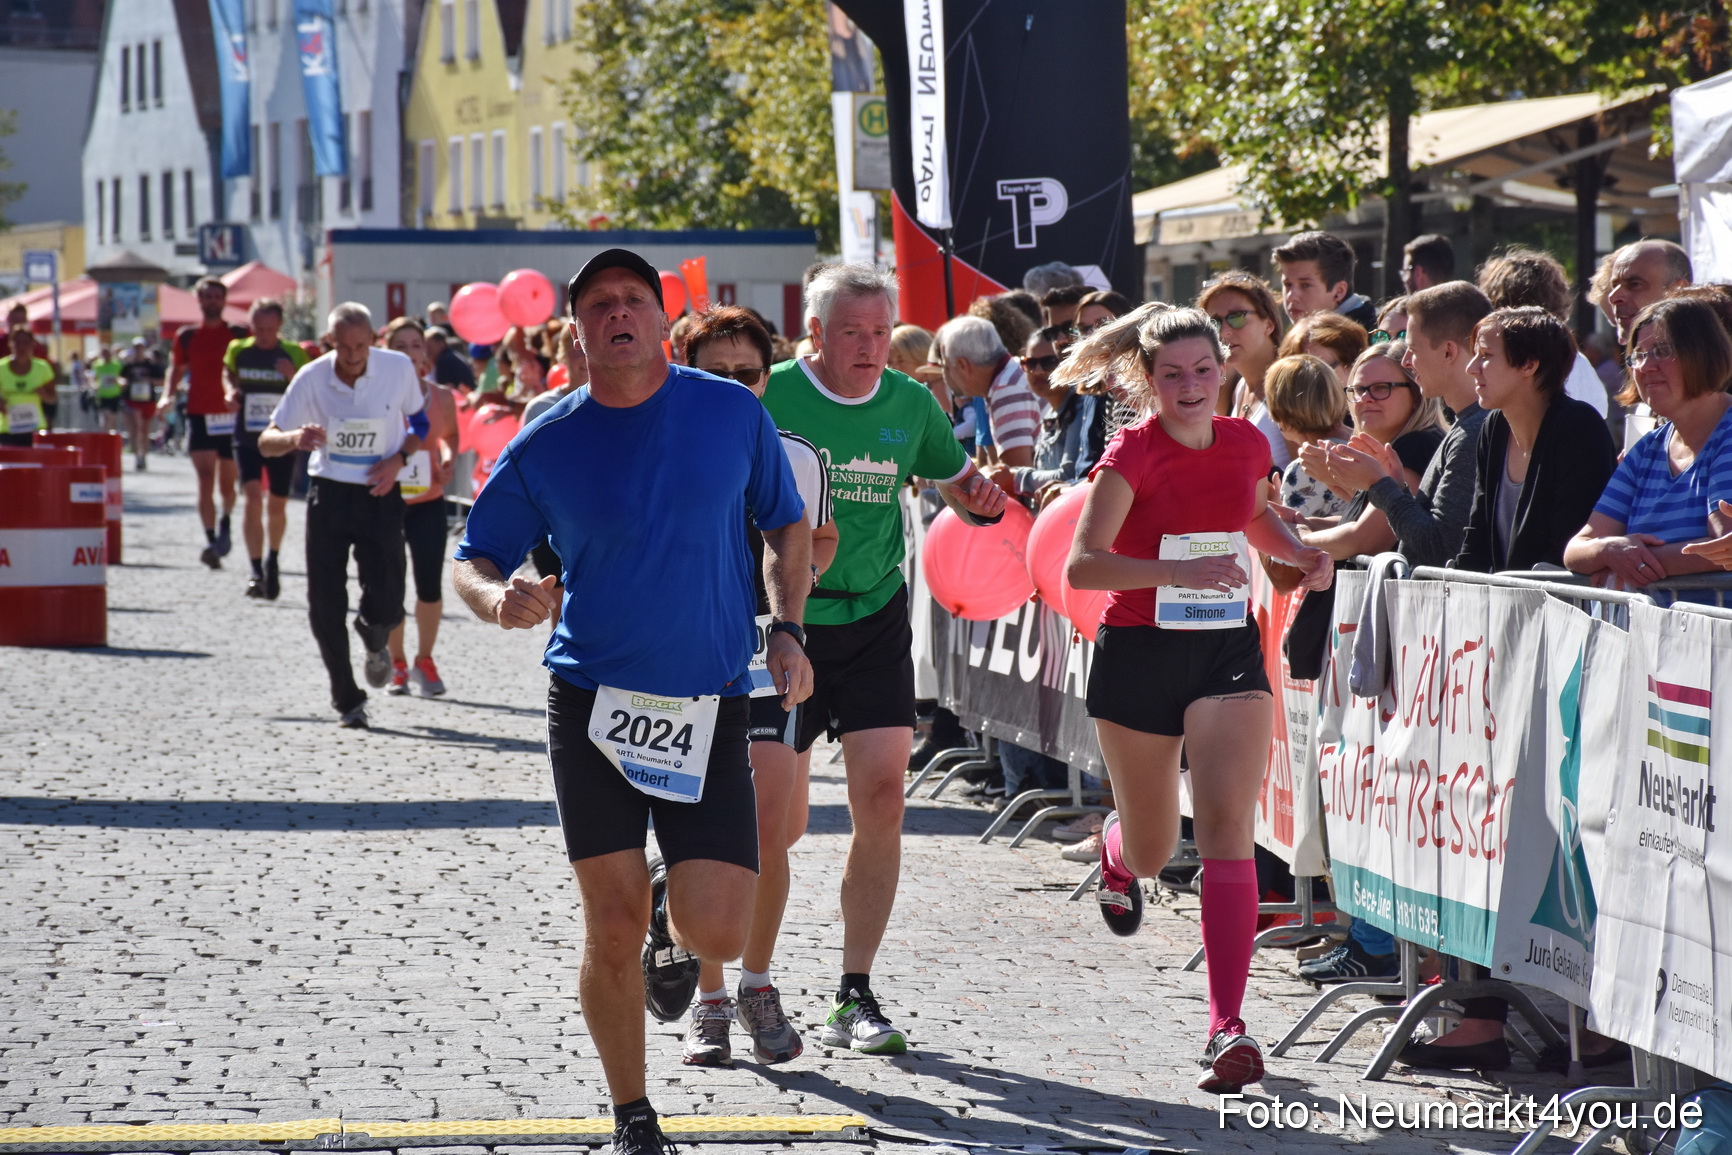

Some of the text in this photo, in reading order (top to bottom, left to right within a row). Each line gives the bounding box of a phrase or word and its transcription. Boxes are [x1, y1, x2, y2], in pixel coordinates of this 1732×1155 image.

[869, 110, 885, 128] H
[1002, 185, 1023, 193] Team
[336, 432, 377, 449] 3077
[829, 471, 897, 487] ENSBURGER
[1190, 542, 1229, 552] BOCK
[1201, 591, 1226, 600] Neumarkt
[1185, 606, 1226, 619] Simone
[632, 695, 682, 712] BOCK
[606, 709, 693, 756] 2024
[615, 748, 671, 766] ARTL Neumarkt
[1525, 938, 1551, 969] Jura
[1668, 1001, 1701, 1031] Neumarkt
